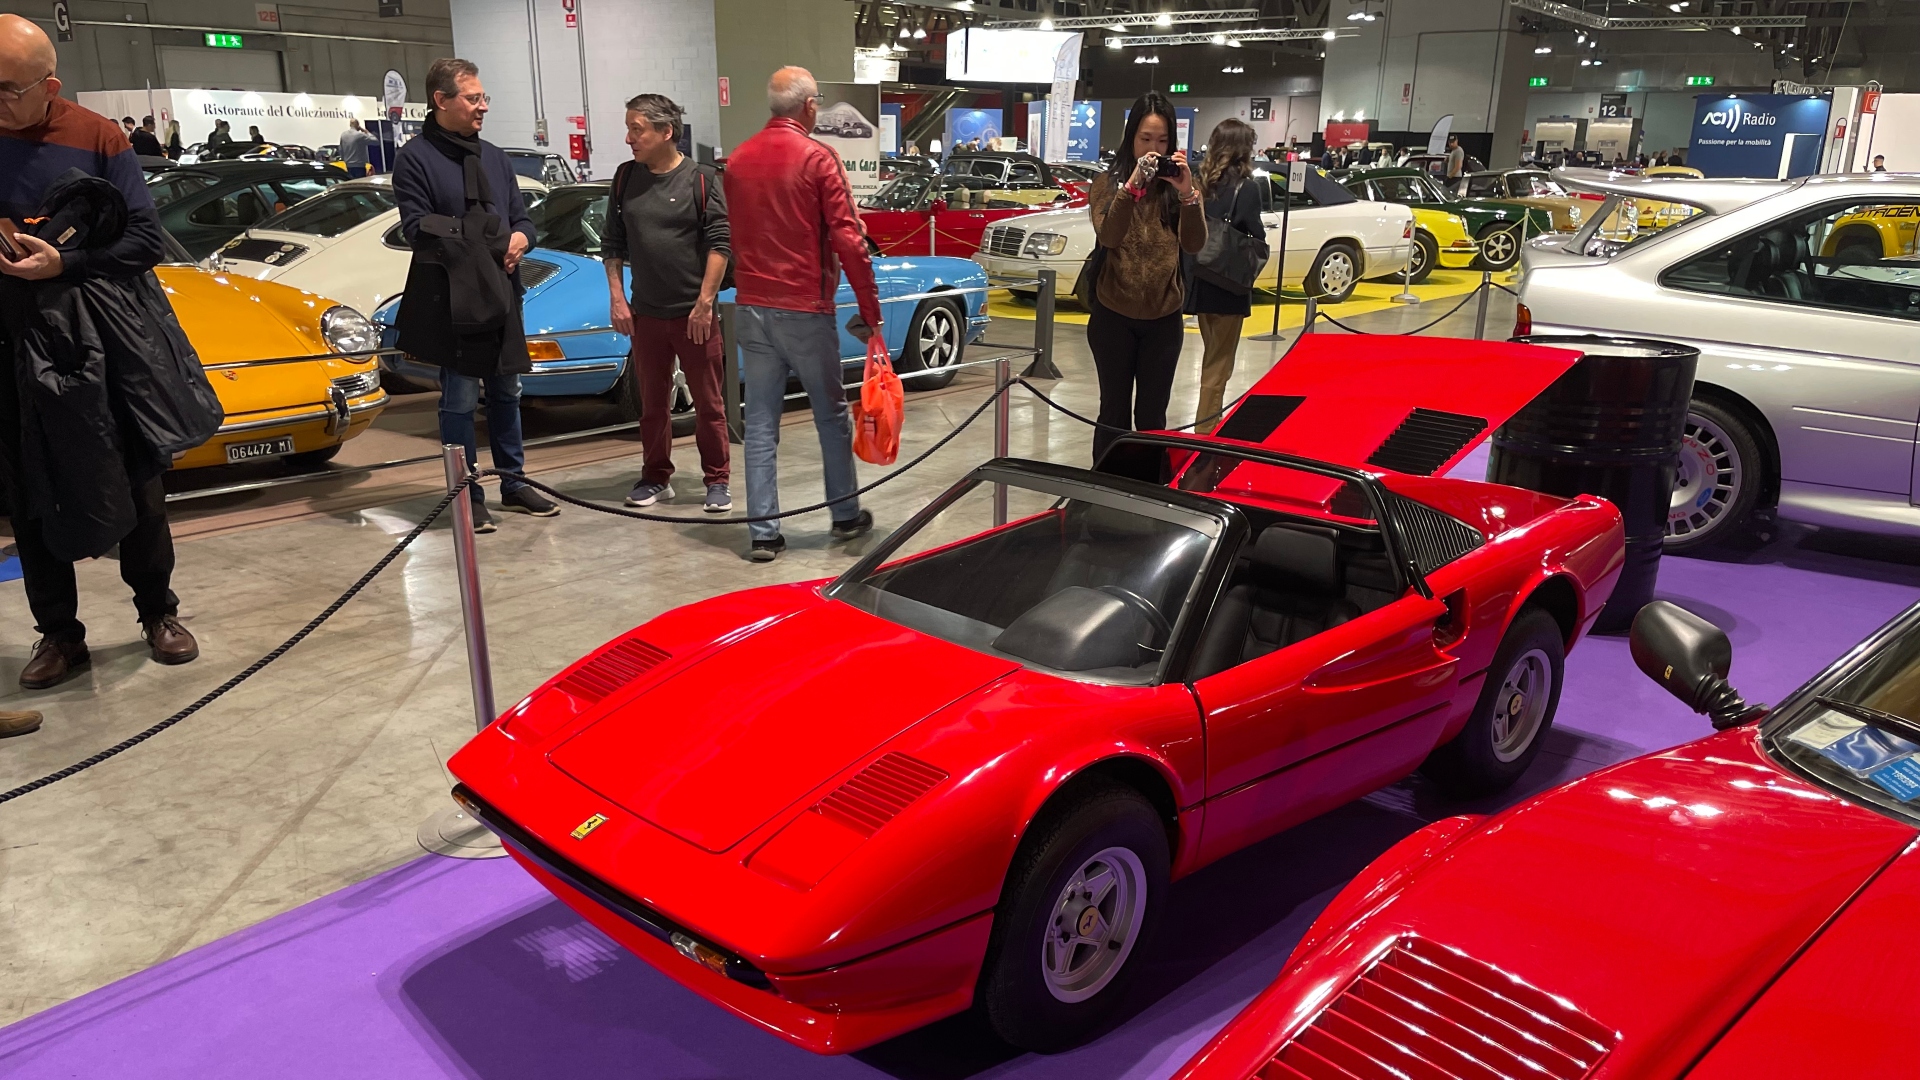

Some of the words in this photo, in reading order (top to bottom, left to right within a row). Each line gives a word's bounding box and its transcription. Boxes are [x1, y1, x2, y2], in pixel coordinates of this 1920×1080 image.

[55, 2, 69, 31] G
[203, 104, 264, 117] Ristorante
[267, 105, 283, 117] del
[286, 106, 354, 119] Collezionista
[1252, 108, 1265, 119] 12
[1601, 105, 1617, 117] 12
[1742, 112, 1776, 125] Radio
[860, 159, 877, 171] Cars
[1292, 172, 1303, 182] D10
